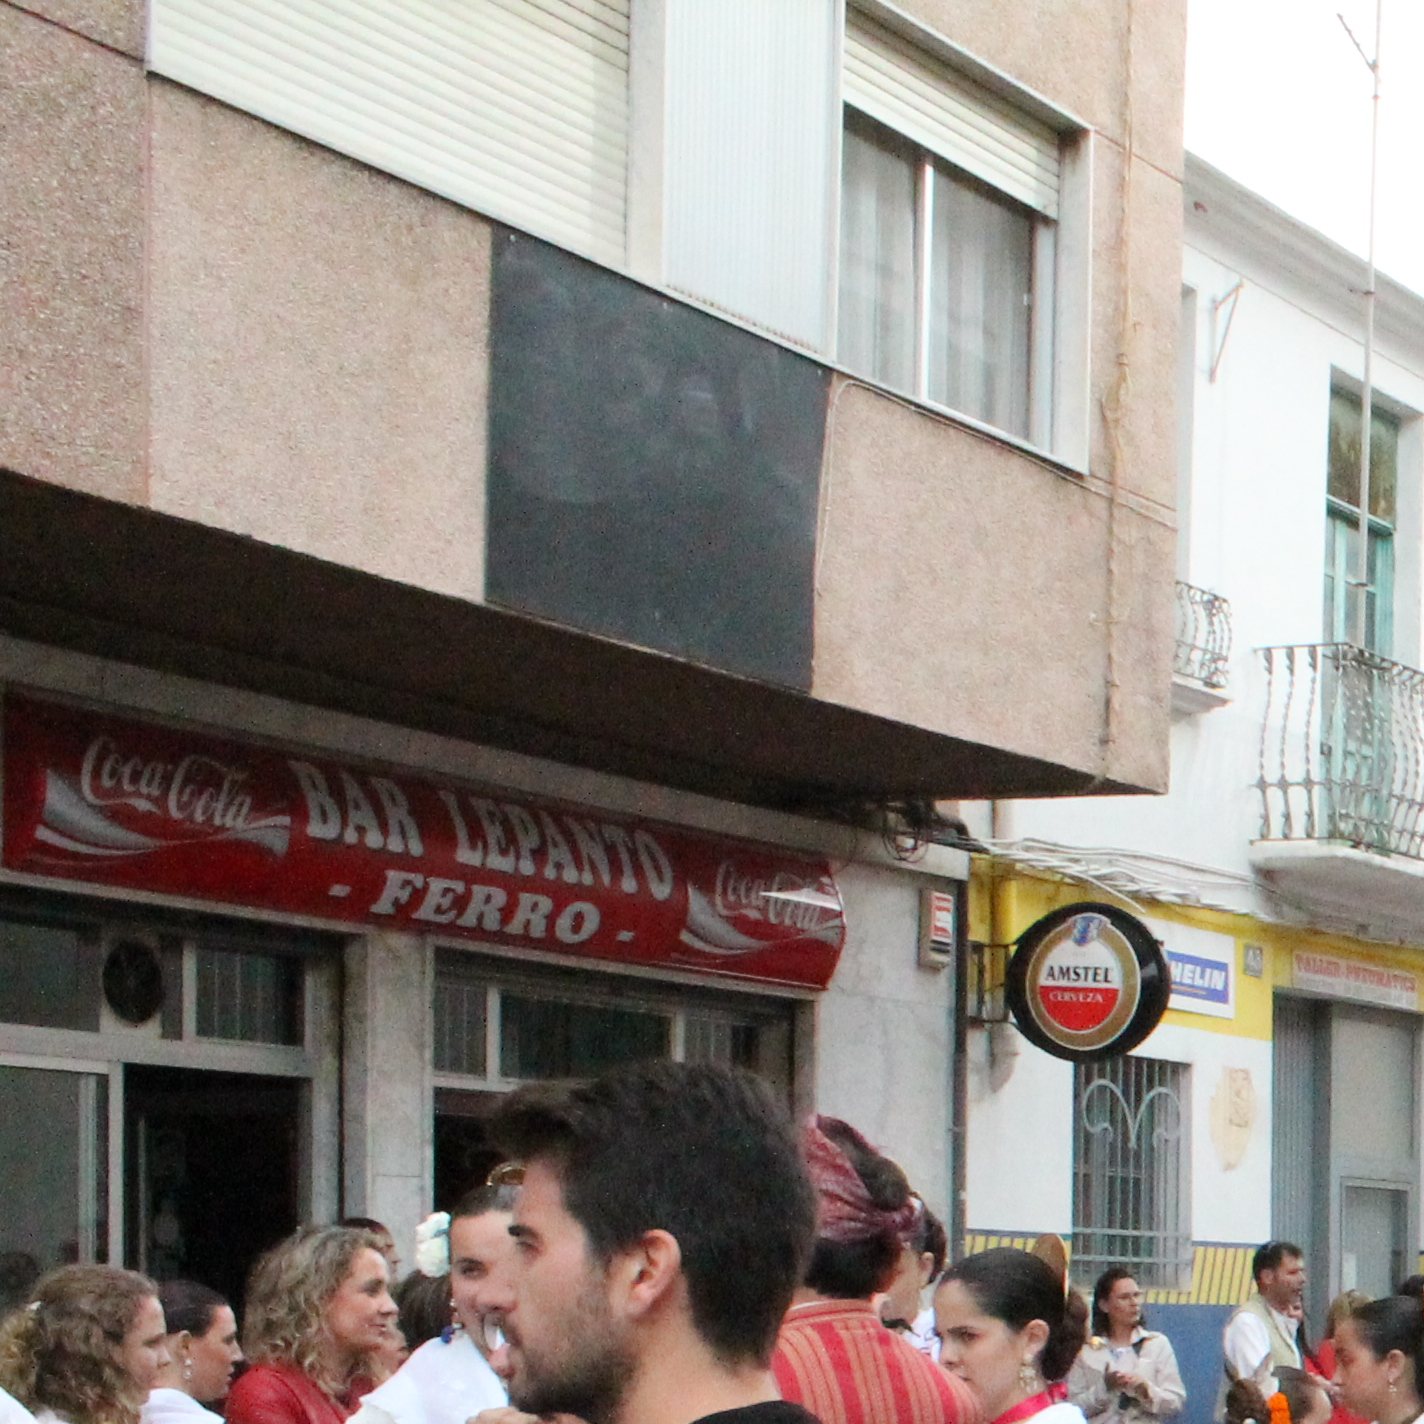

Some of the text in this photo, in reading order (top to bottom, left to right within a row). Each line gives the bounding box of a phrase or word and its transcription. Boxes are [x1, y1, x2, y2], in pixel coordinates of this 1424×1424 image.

[288, 760, 674, 901] BAR LEPANTO
[369, 869, 601, 944] FERRO
[1045, 965, 1113, 984] AMSTEL
[1170, 960, 1227, 992] HELIN
[1049, 991, 1105, 1004] CERVEZA
